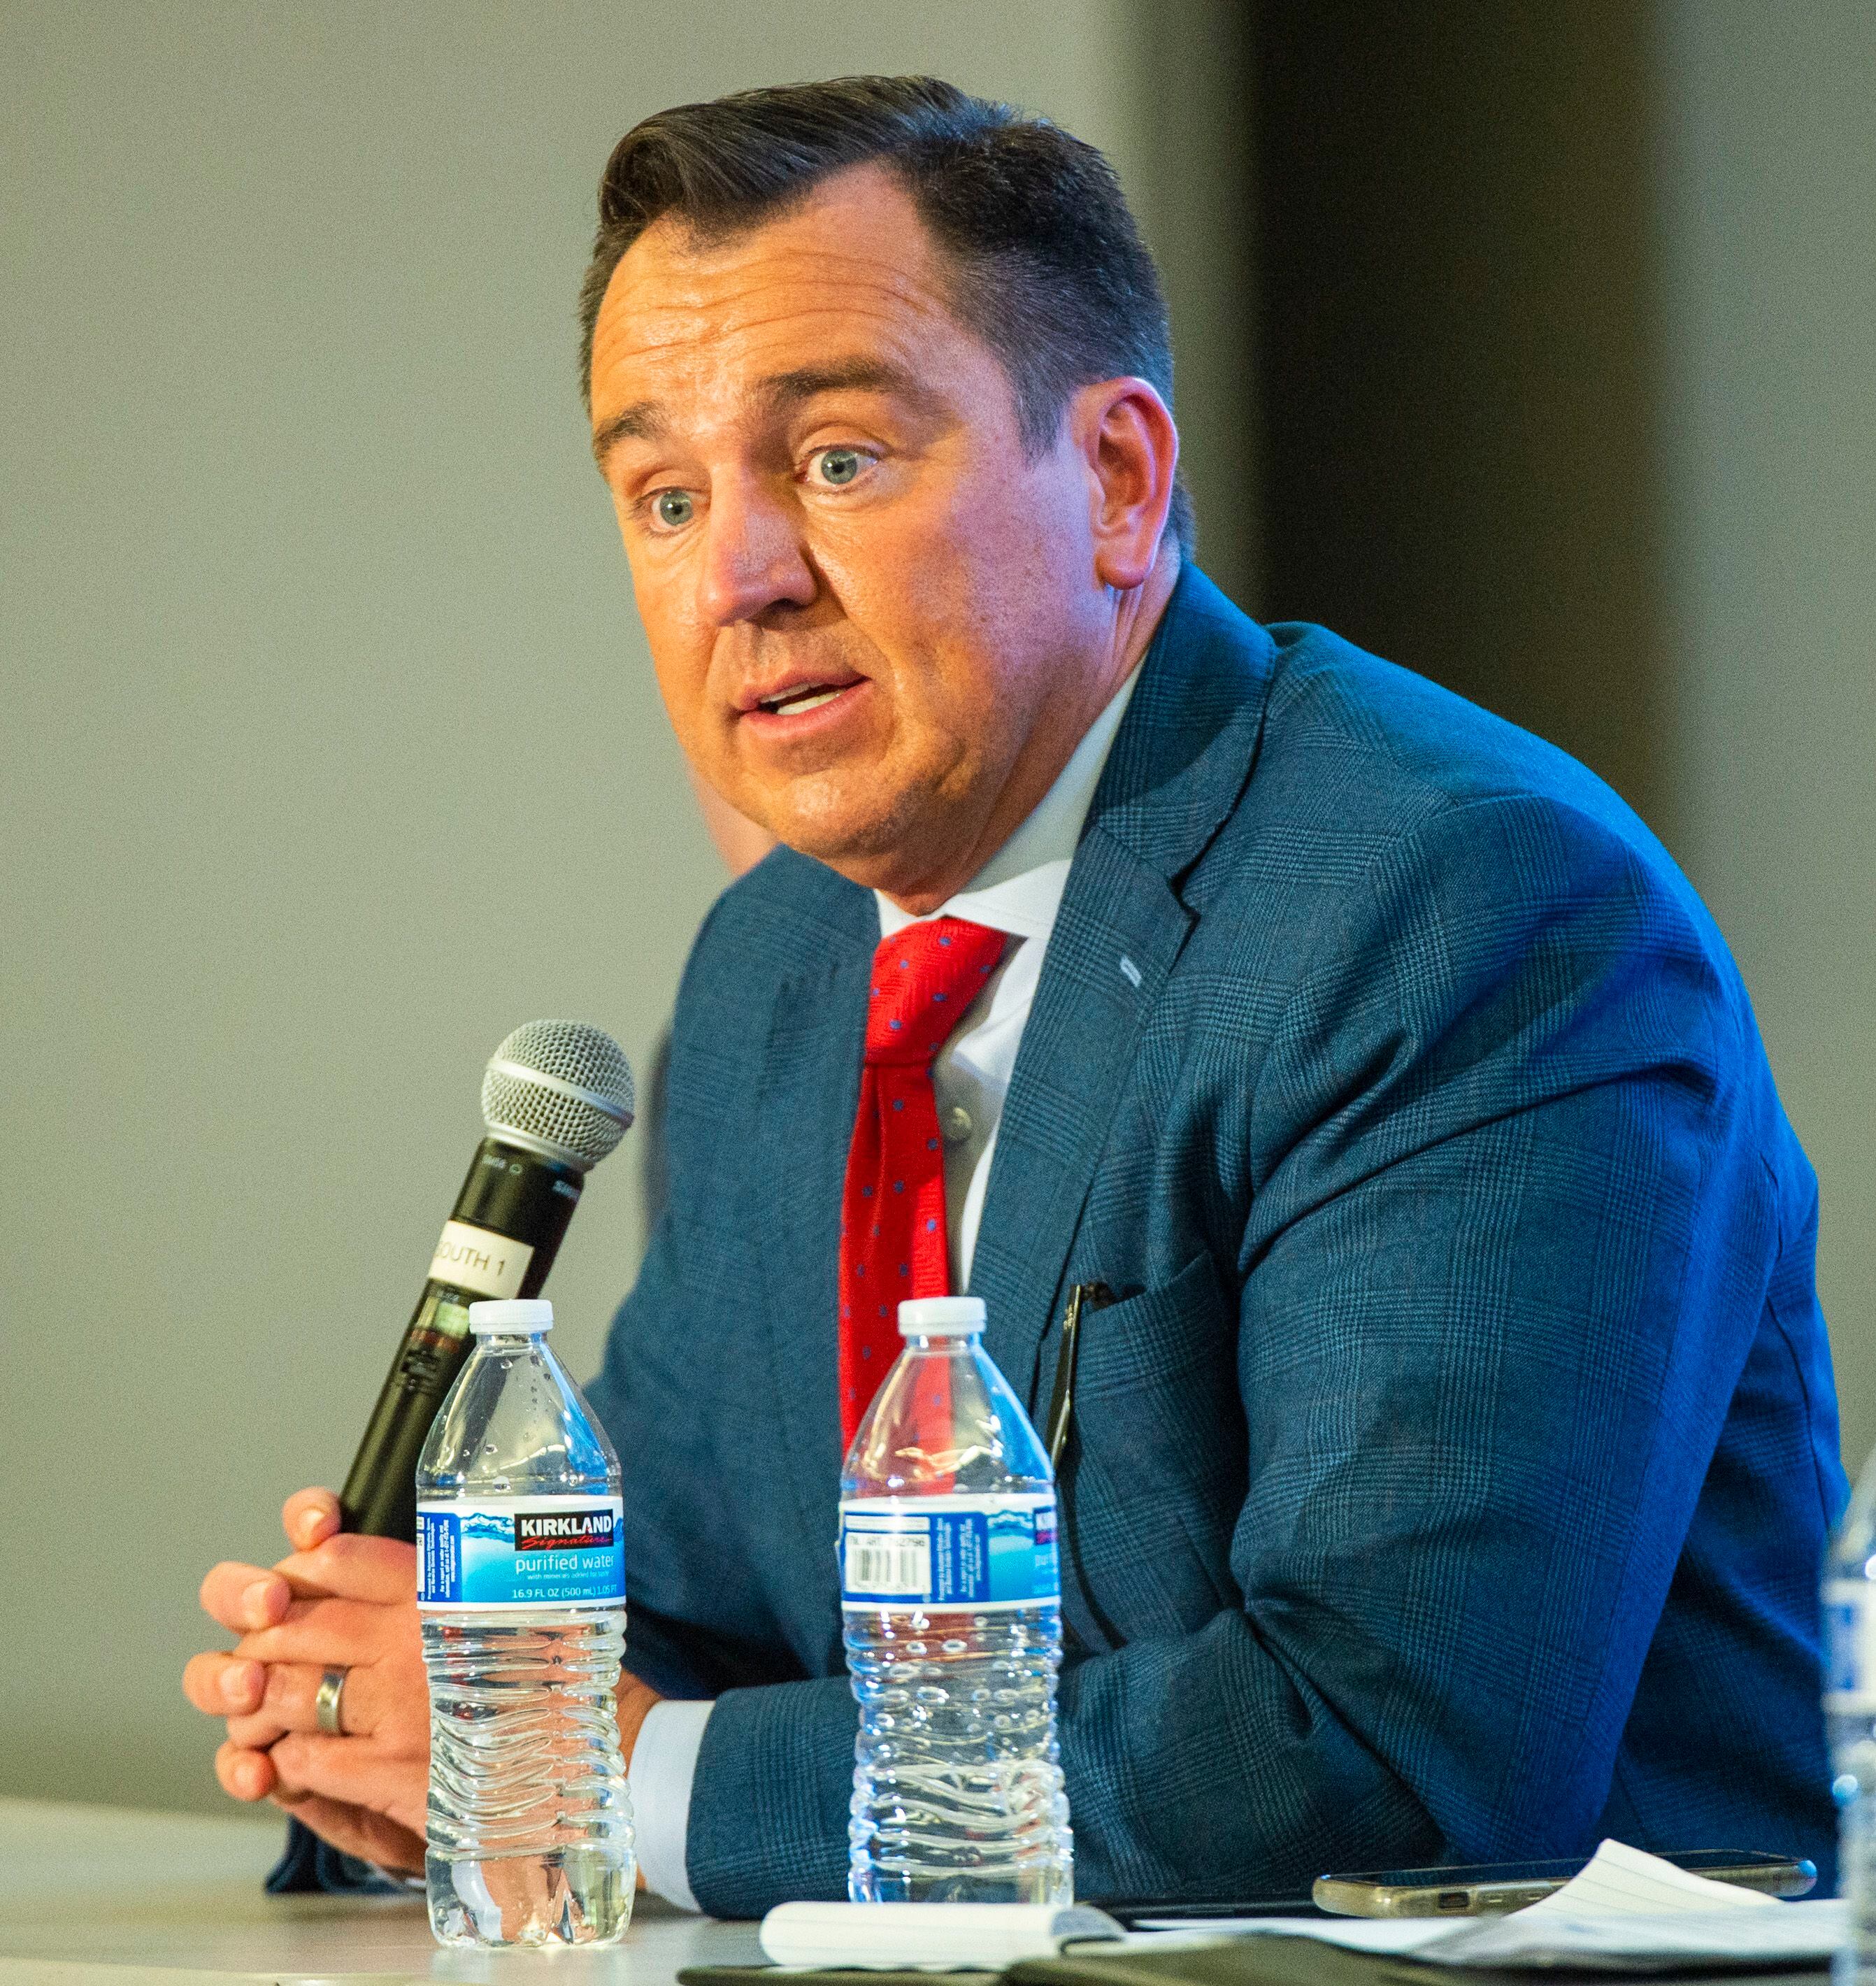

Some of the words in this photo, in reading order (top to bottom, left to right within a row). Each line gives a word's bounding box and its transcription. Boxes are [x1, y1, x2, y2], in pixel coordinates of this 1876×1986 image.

[434, 1241, 491, 1271] OUTH
[496, 1259, 506, 1276] 1
[521, 1515, 613, 1537] KIRKLAND
[521, 1535, 613, 1551] Signature
[515, 1554, 578, 1576] purified
[582, 1554, 615, 1569] water
[513, 1588, 533, 1599] 16.9
[535, 1588, 545, 1598] FL
[547, 1587, 559, 1598] OZ
[561, 1587, 581, 1598] (500
[582, 1586, 596, 1597] mL)
